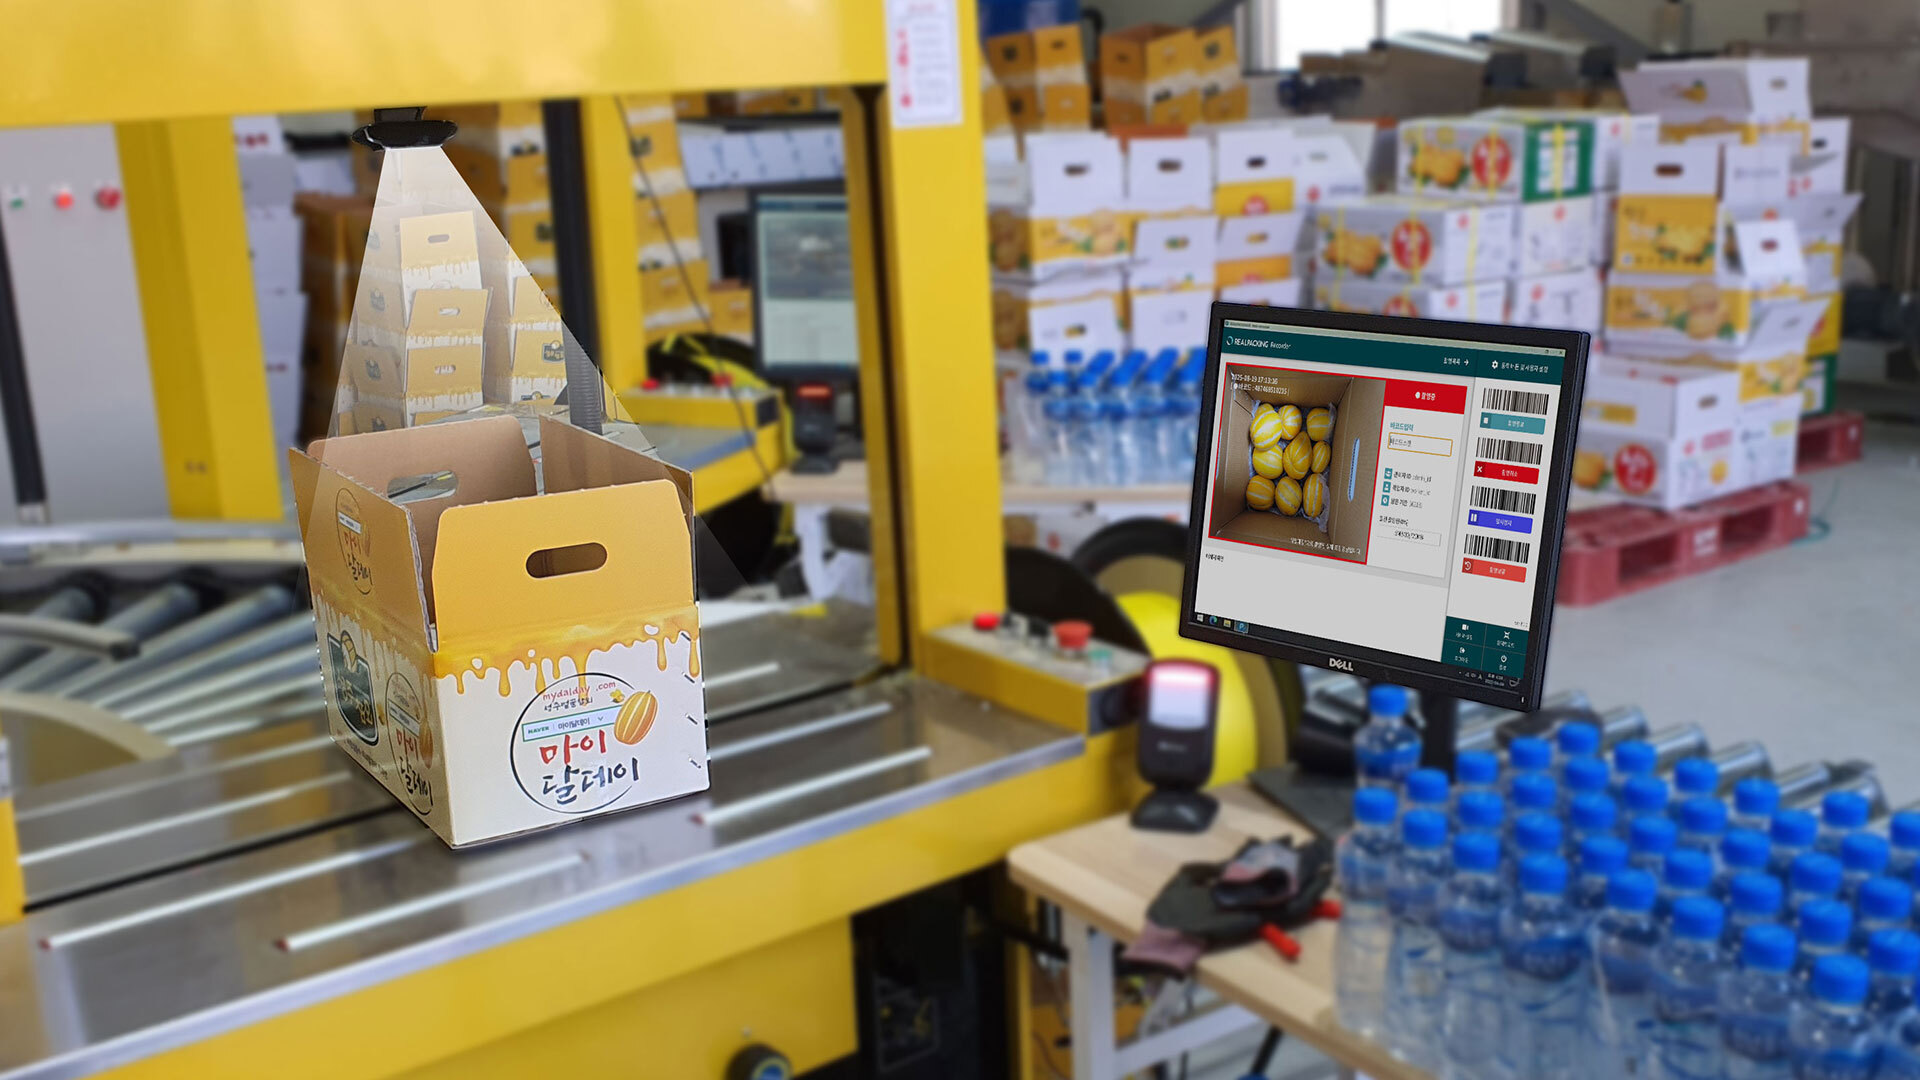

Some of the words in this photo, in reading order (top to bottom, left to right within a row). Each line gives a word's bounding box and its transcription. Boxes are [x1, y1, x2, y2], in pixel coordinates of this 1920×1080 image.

[1234, 338, 1269, 348] REALPACKING
[1328, 657, 1354, 672] DELL
[396, 726, 419, 761] 마이
[527, 726, 550, 734] NAVER
[539, 729, 607, 765] 마이
[399, 755, 434, 807] 달데이
[542, 757, 640, 805] 달데이
